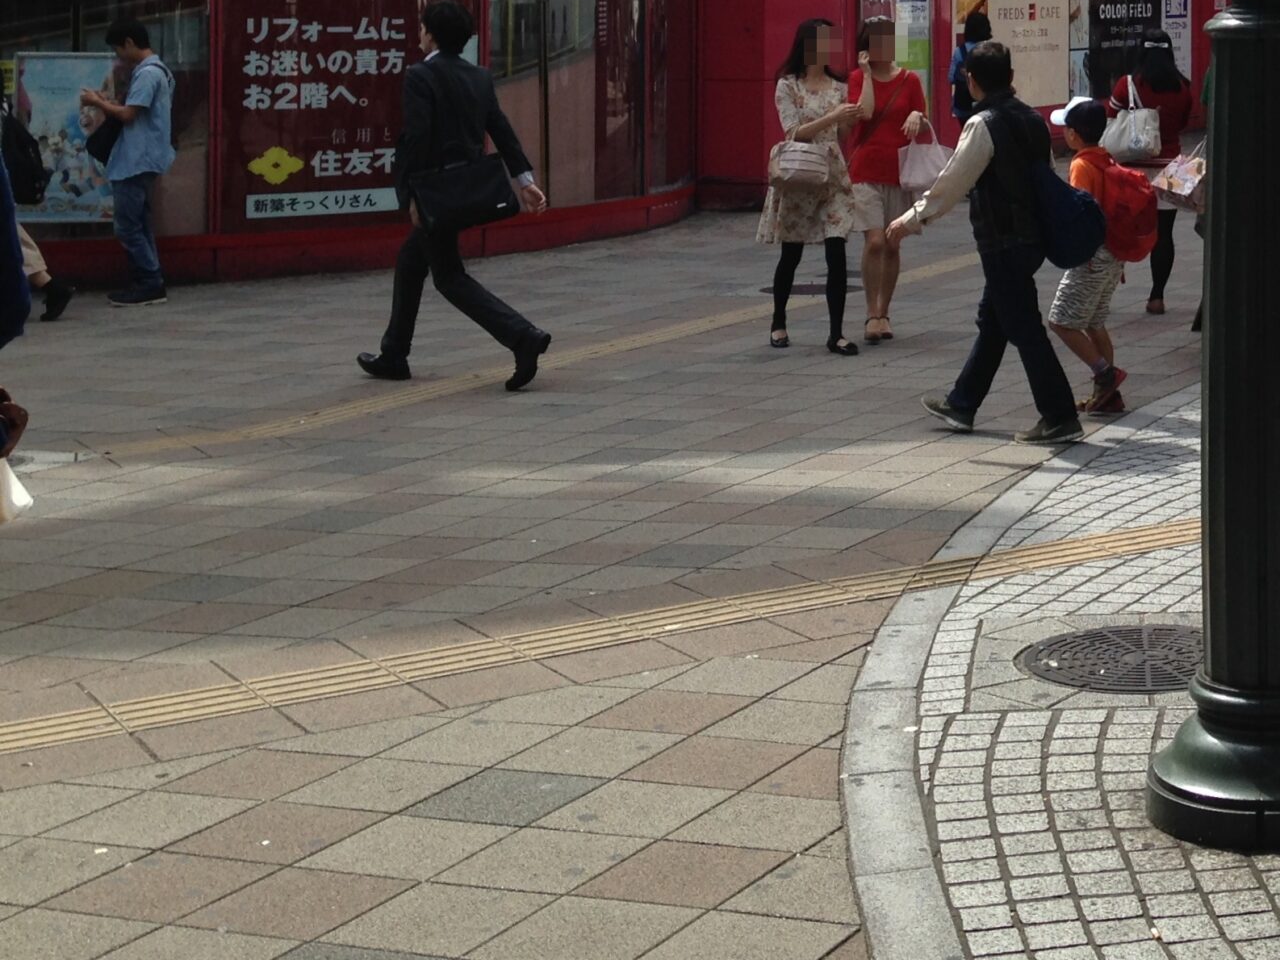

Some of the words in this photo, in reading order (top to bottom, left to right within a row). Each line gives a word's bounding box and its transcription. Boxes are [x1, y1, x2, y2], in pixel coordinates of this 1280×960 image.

[998, 7, 1025, 20] FREDS
[1040, 6, 1061, 19] CAFE
[1099, 3, 1128, 19] COLOR
[246, 16, 406, 44] リフォームに
[242, 48, 406, 77] お迷いの貴方
[242, 82, 369, 111] お2階へ。
[253, 193, 377, 213] 新築そっくりさん
